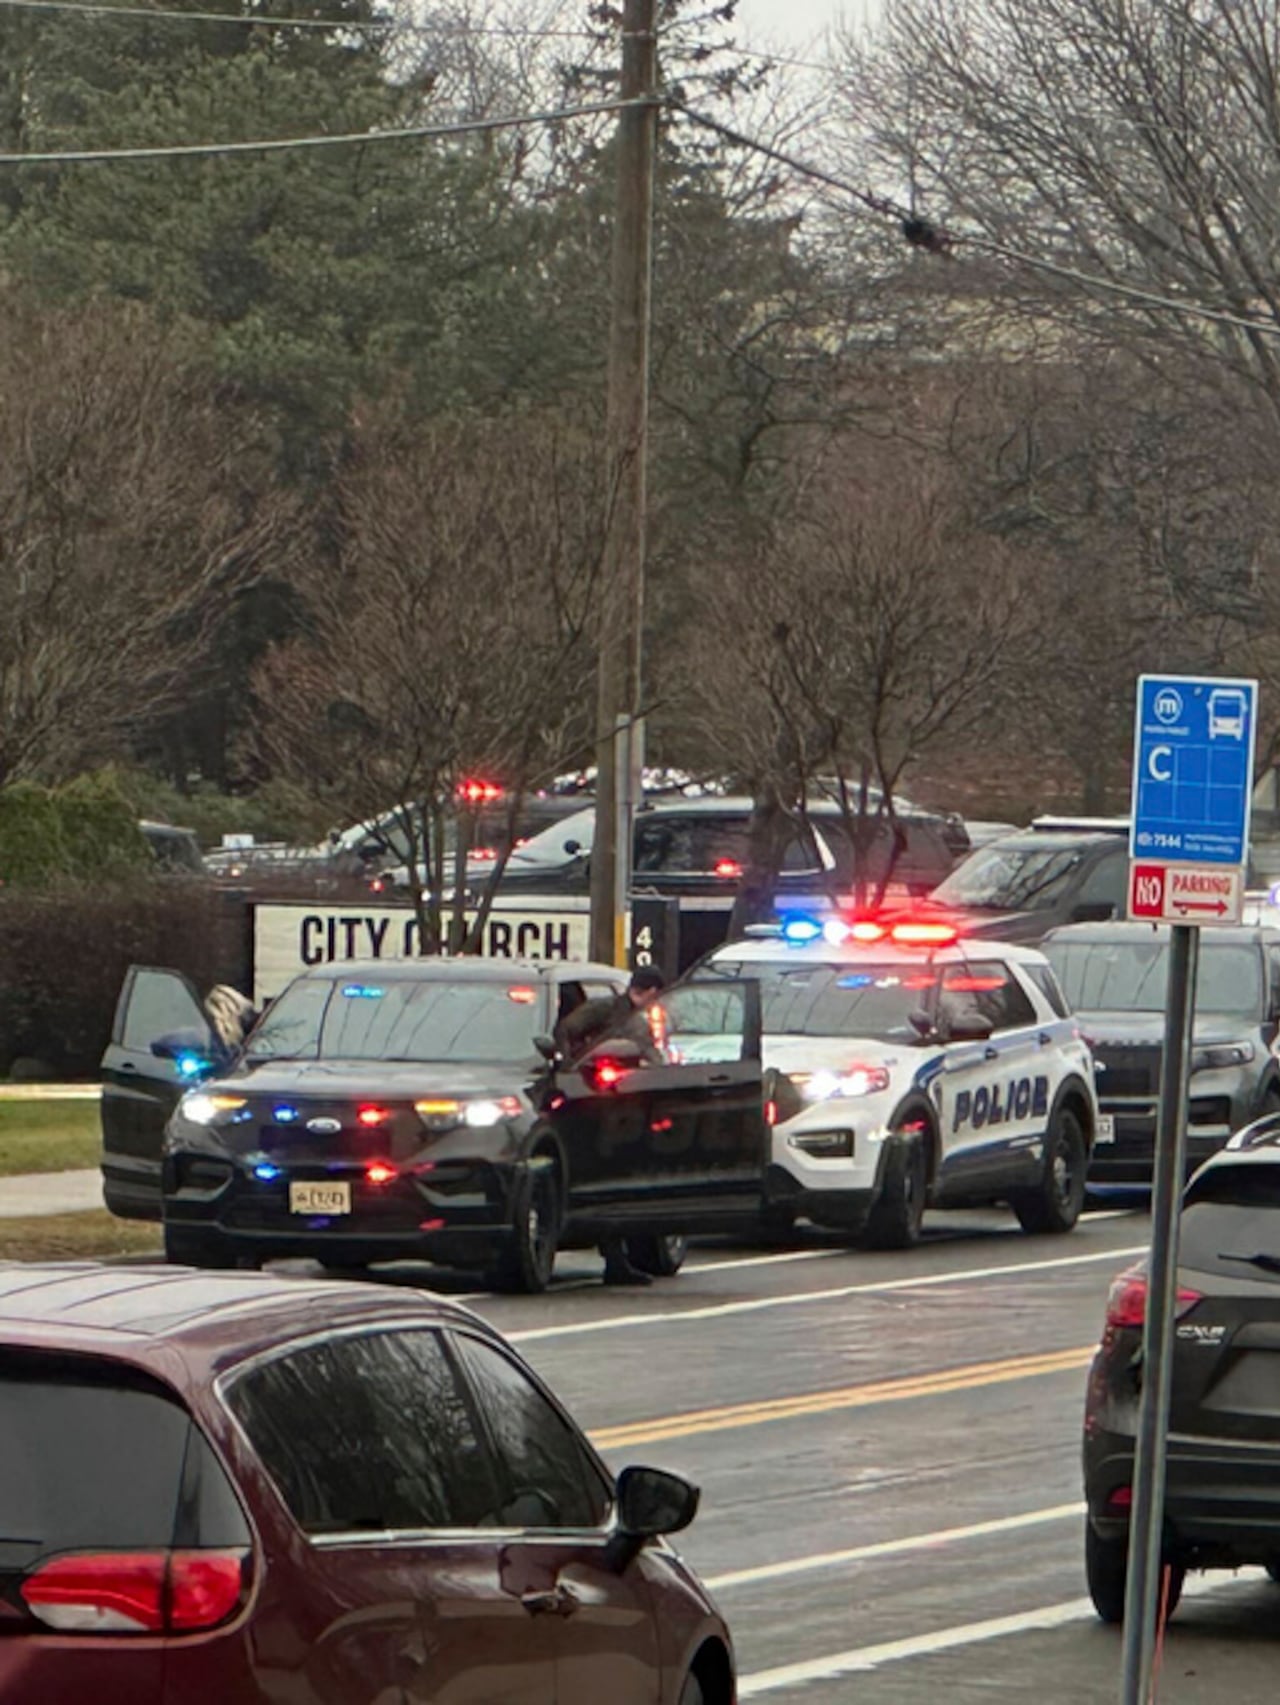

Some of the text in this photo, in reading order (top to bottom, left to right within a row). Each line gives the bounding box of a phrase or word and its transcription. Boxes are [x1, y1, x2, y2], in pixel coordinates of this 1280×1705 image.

[1148, 744, 1172, 781] C
[1136, 876, 1162, 907] NO
[1172, 873, 1232, 896] PARKING
[301, 915, 569, 966] CITY CRCH
[953, 1074, 1048, 1133] POLICE
